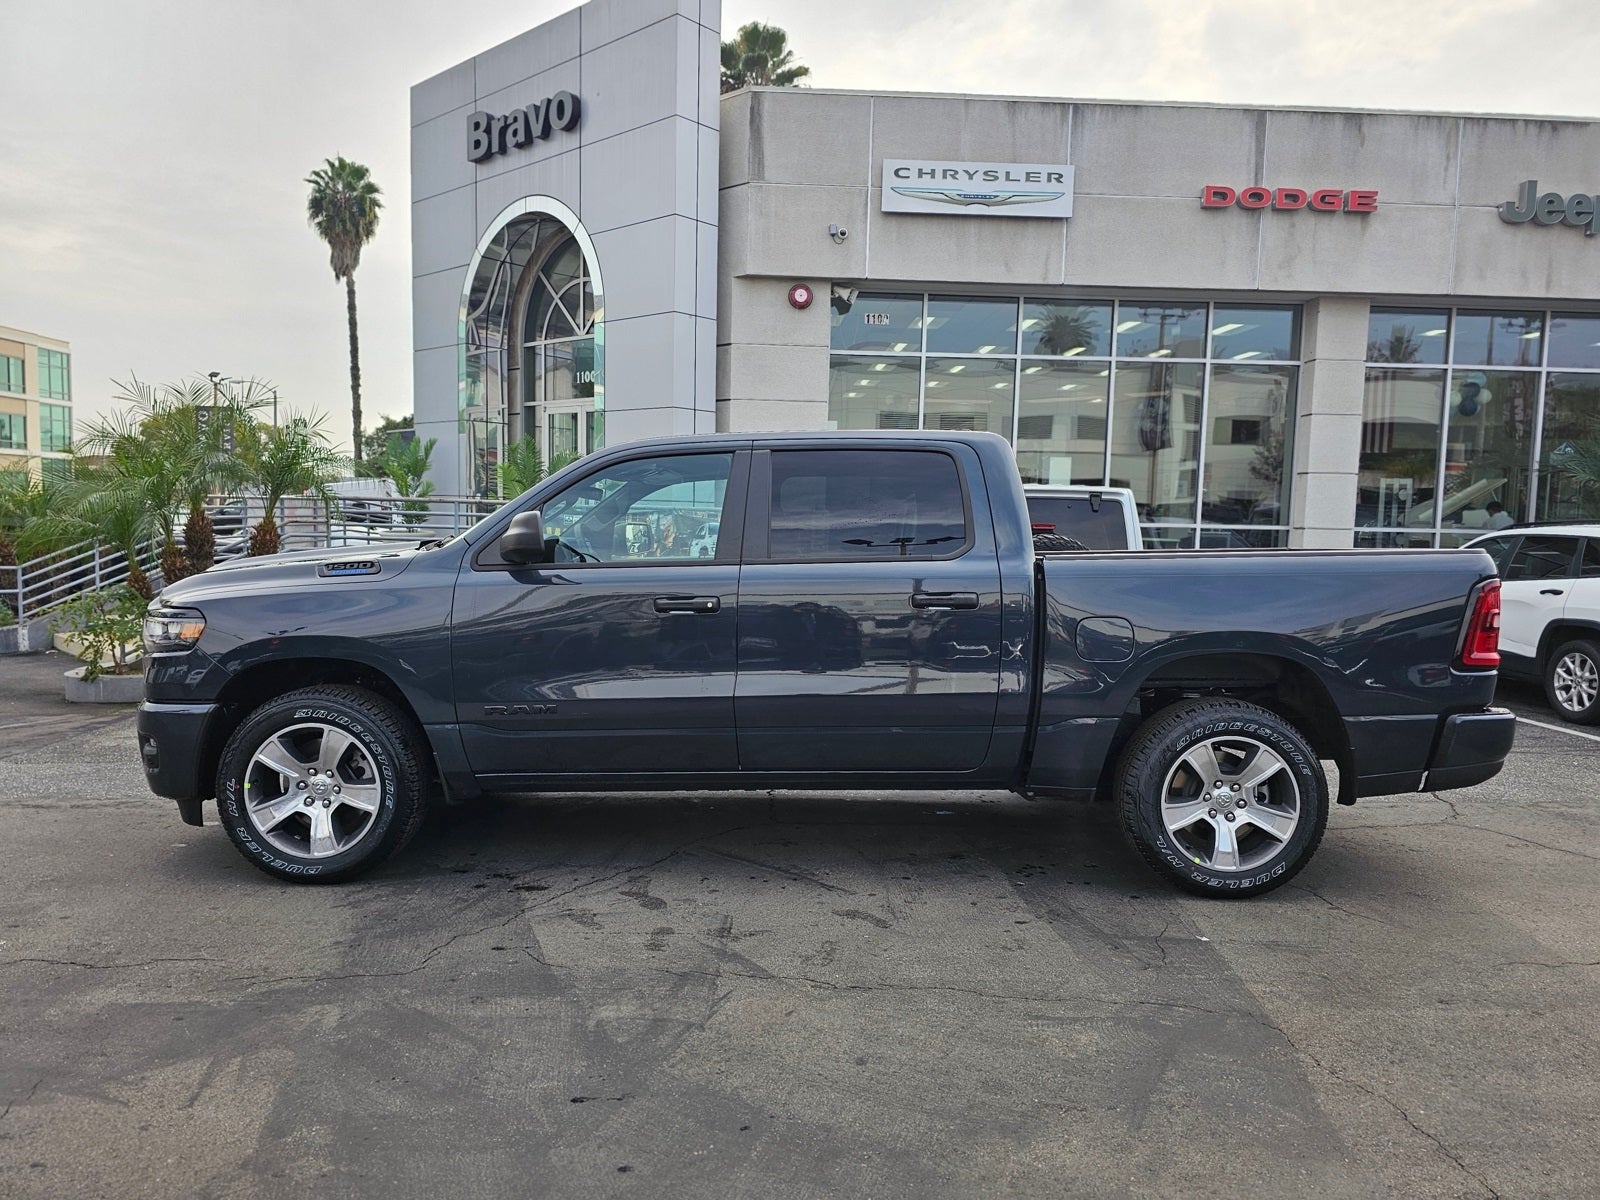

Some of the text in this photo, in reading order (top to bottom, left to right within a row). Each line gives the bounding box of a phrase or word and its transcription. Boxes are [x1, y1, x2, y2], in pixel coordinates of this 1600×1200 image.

[467, 90, 581, 163] Bravo
[893, 167, 1065, 184] CHRYSLER
[1200, 185, 1379, 213] DODGE
[1498, 180, 1600, 237] Jee
[326, 562, 372, 570] 1500
[484, 704, 558, 715] RAM
[294, 708, 394, 809] BRIDGESTONE
[1176, 721, 1312, 776] BRIDGESTONE
[226, 778, 322, 874] DUELER H/L
[1156, 835, 1286, 889] DUELER H/L
